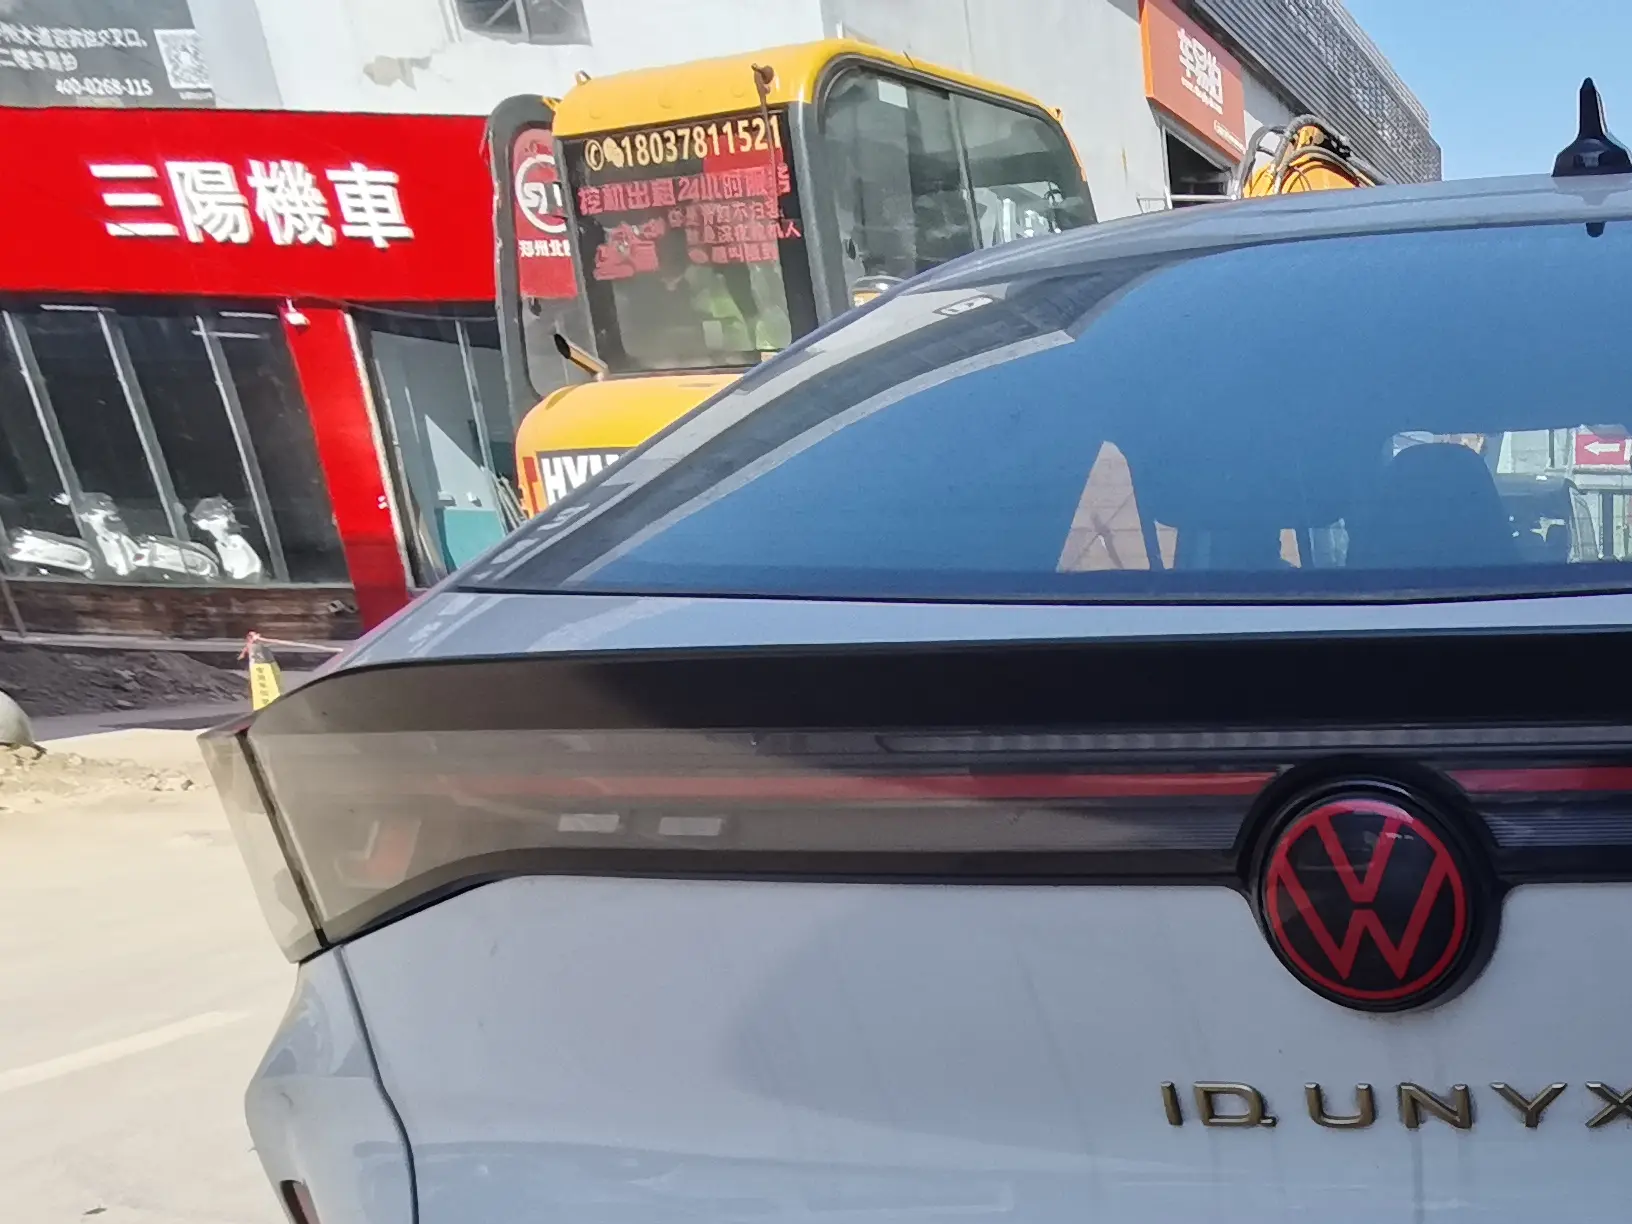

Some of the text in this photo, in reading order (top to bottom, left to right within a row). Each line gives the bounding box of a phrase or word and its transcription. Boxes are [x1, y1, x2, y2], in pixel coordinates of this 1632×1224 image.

[622, 115, 782, 167] 18037811521
[89, 160, 415, 250] 三陽機車
